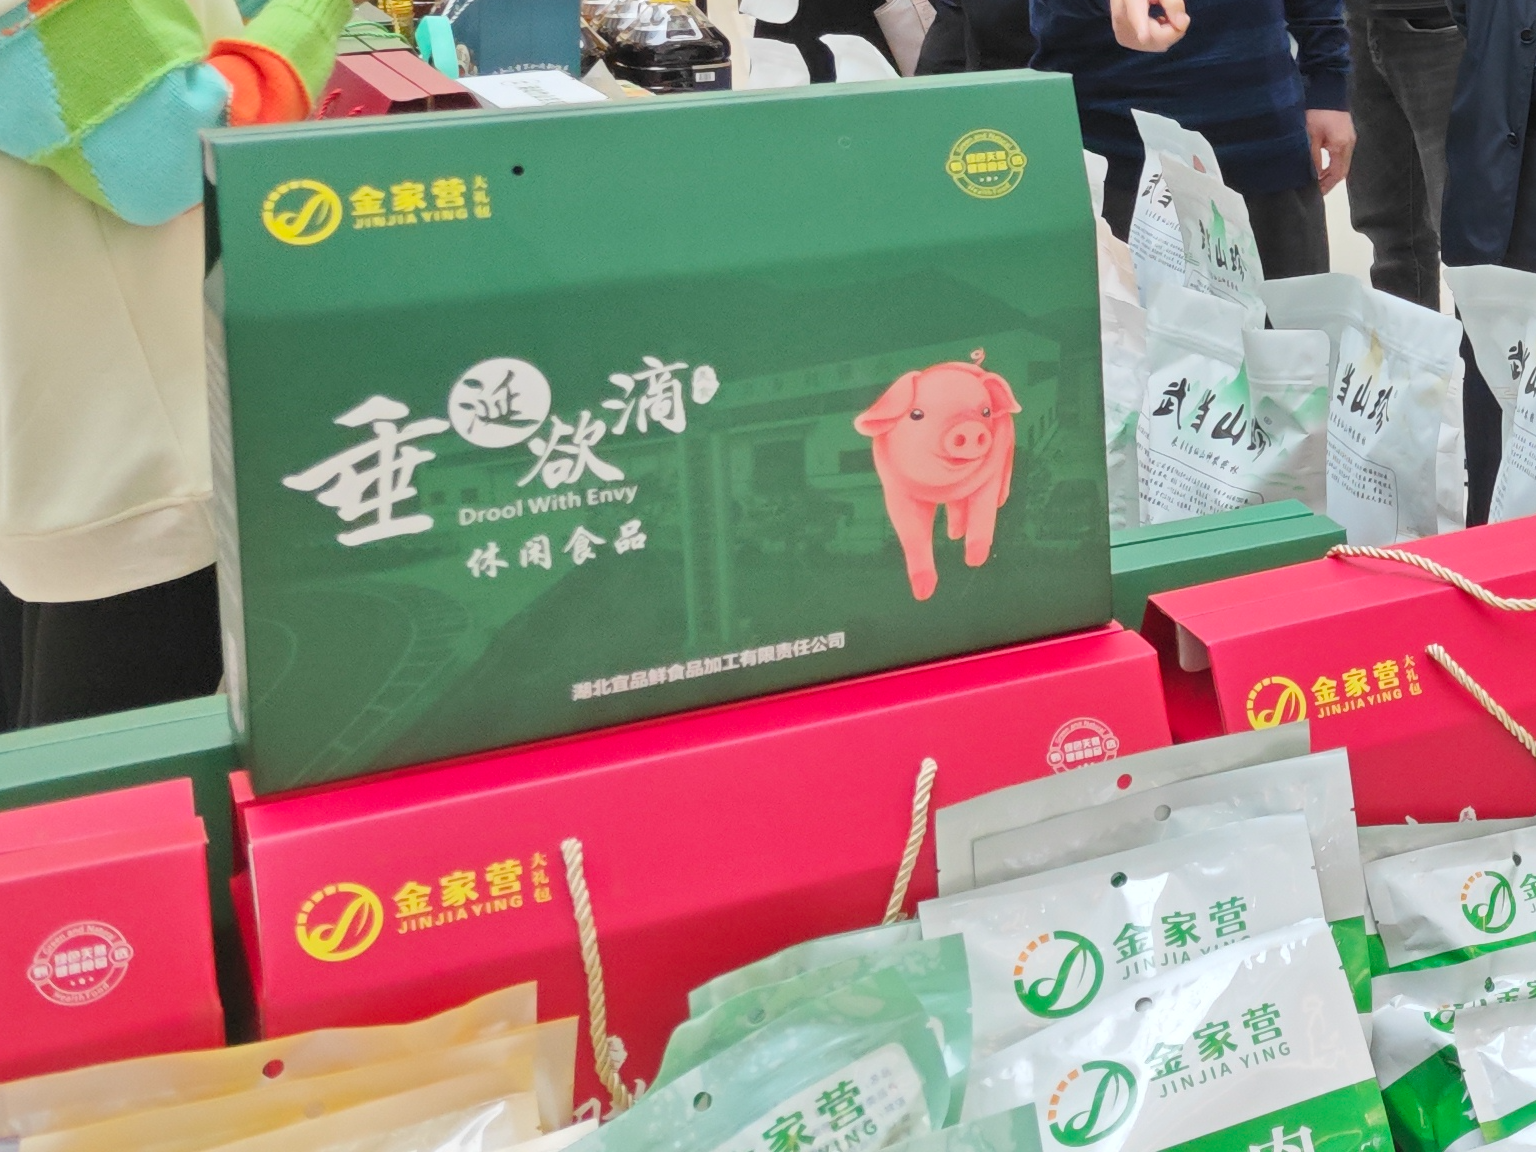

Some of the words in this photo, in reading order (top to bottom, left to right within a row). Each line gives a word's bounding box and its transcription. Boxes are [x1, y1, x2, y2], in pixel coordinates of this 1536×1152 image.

[350, 176, 467, 216] 金家营
[281, 356, 690, 547] 垂涎欲滴
[458, 499, 524, 527] Drool
[528, 491, 582, 515] With
[586, 484, 639, 508] Envy
[466, 518, 648, 579] 休闲食品
[571, 631, 846, 702] 湖北宜品鲜食品加工有限责任公司
[1310, 659, 1400, 706] 金家营
[1403, 654, 1422, 696] 大礼包
[391, 858, 523, 919] 金家营
[530, 851, 552, 903] 大礼包
[1113, 896, 1247, 964] 金家营
[1122, 951, 1191, 980] JINJIA
[1145, 1002, 1283, 1081] 金家营
[1160, 1062, 1232, 1098] JINJIA
[1239, 1041, 1291, 1069] YING
[750, 1080, 865, 1152] 家营
